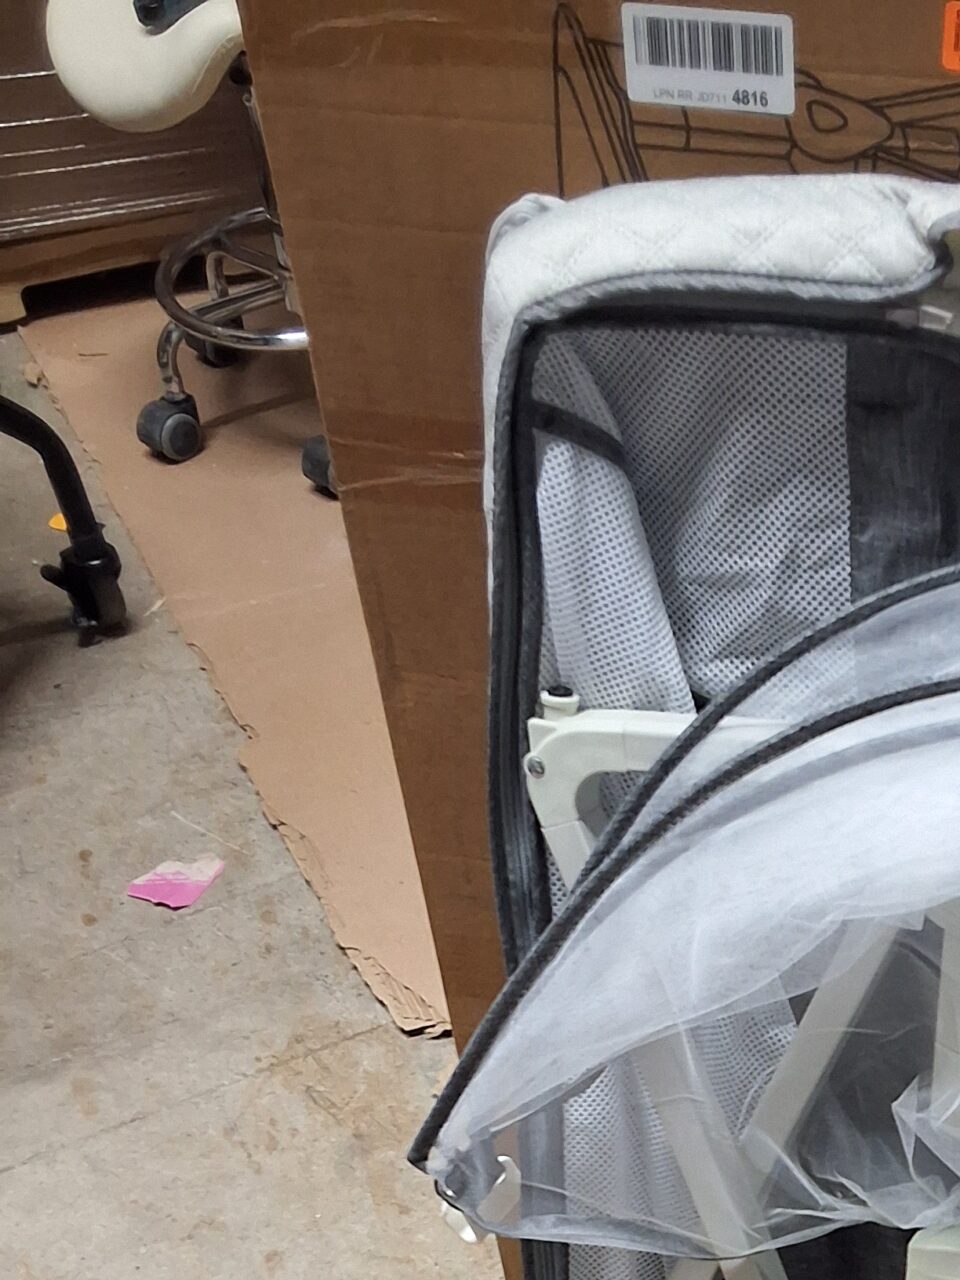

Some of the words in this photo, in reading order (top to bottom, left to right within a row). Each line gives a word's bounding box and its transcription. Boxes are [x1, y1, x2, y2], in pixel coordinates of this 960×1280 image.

[653, 87, 675, 100] LPN
[677, 89, 693, 101] RR
[732, 89, 769, 107] 4816
